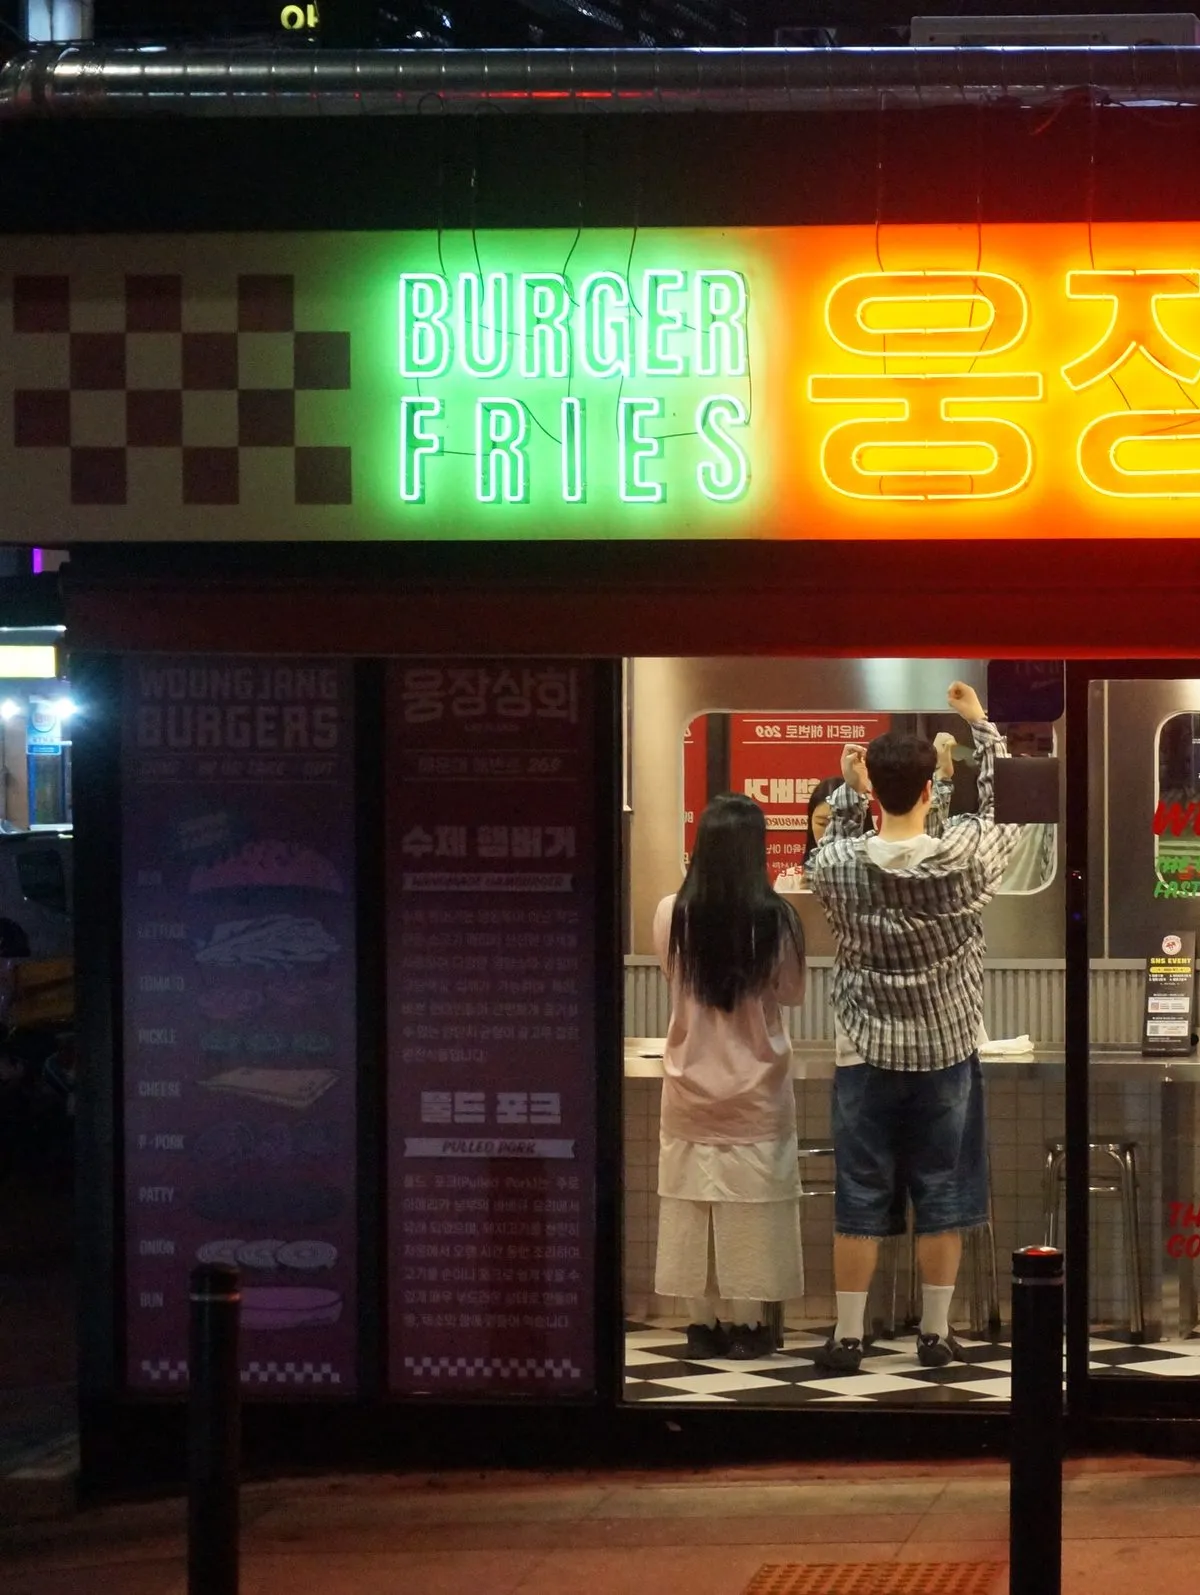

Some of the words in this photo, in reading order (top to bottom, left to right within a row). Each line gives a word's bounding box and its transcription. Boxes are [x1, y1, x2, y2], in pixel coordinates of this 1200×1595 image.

[400, 270, 748, 379] BURGER
[400, 394, 748, 503] FRIES
[401, 667, 579, 723] 웅장상회
[137, 706, 339, 748] BURGERS
[139, 1080, 182, 1097] CHEESE
[442, 1140, 495, 1154] PULLED
[498, 1141, 536, 1154] PORK
[139, 1187, 174, 1202] PATTY
[140, 1240, 175, 1256] ONION
[140, 1292, 164, 1307] BUN
